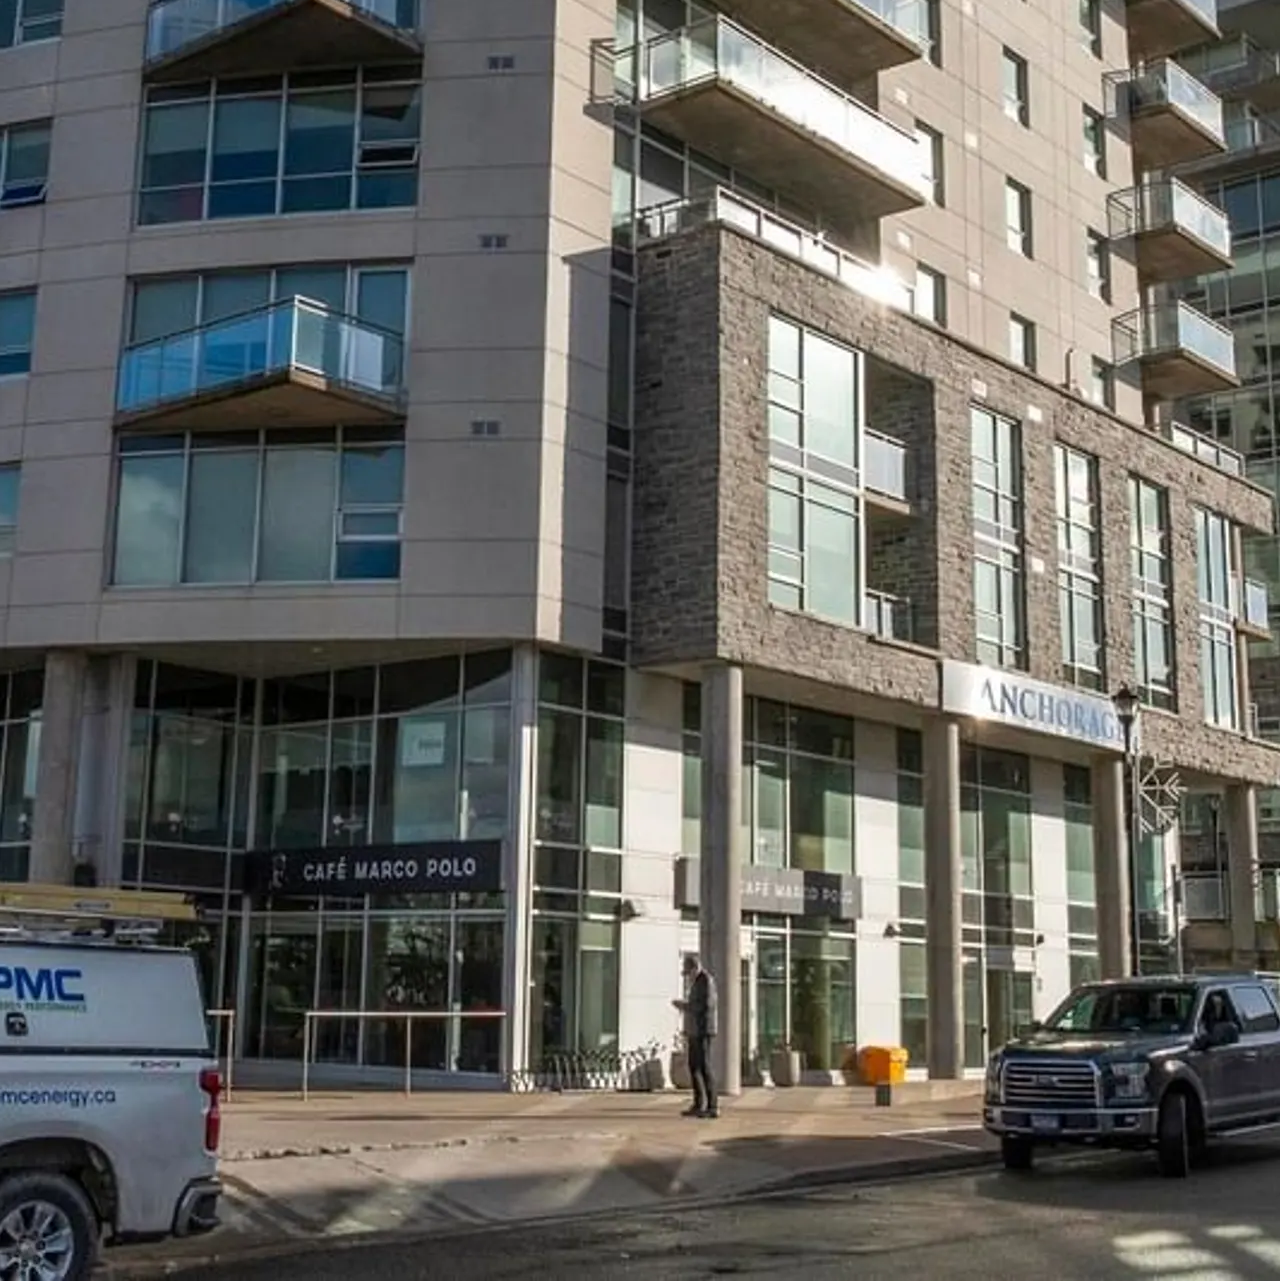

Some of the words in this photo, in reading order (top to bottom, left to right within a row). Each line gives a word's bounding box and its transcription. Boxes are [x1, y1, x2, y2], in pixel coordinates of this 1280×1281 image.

[303, 856, 347, 881] CAFÉ
[354, 860, 419, 880] MARCO
[426, 857, 477, 878] POLO
